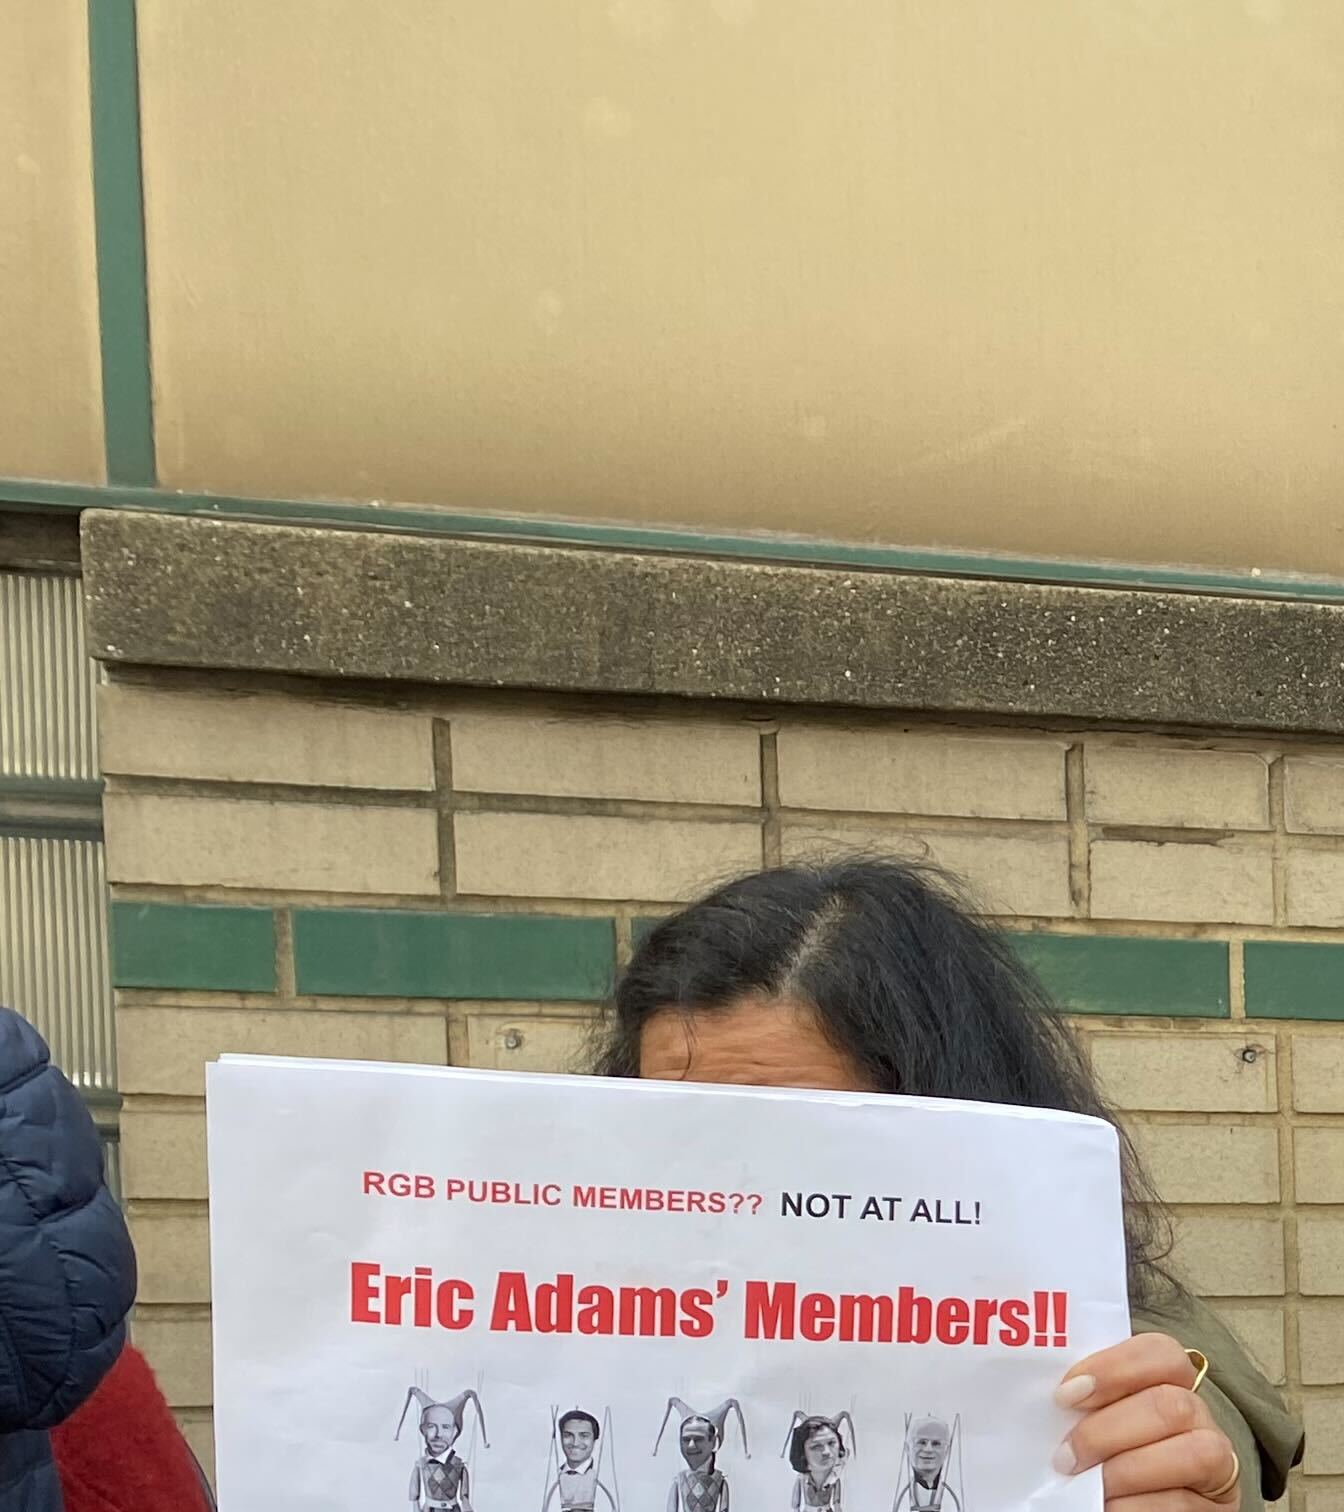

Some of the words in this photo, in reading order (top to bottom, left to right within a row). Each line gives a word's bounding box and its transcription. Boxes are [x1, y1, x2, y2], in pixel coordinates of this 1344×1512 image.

[362, 1171, 436, 1199] RGB
[447, 1178, 562, 1207] PUBLIC
[573, 1184, 763, 1215] MEMBERS??
[780, 1191, 852, 1220] NOT
[859, 1196, 902, 1222] AT
[909, 1199, 982, 1225] ALL!
[350, 1261, 475, 1331] Eric
[489, 1271, 729, 1338] Adams’
[744, 1280, 1068, 1348] Members!!
